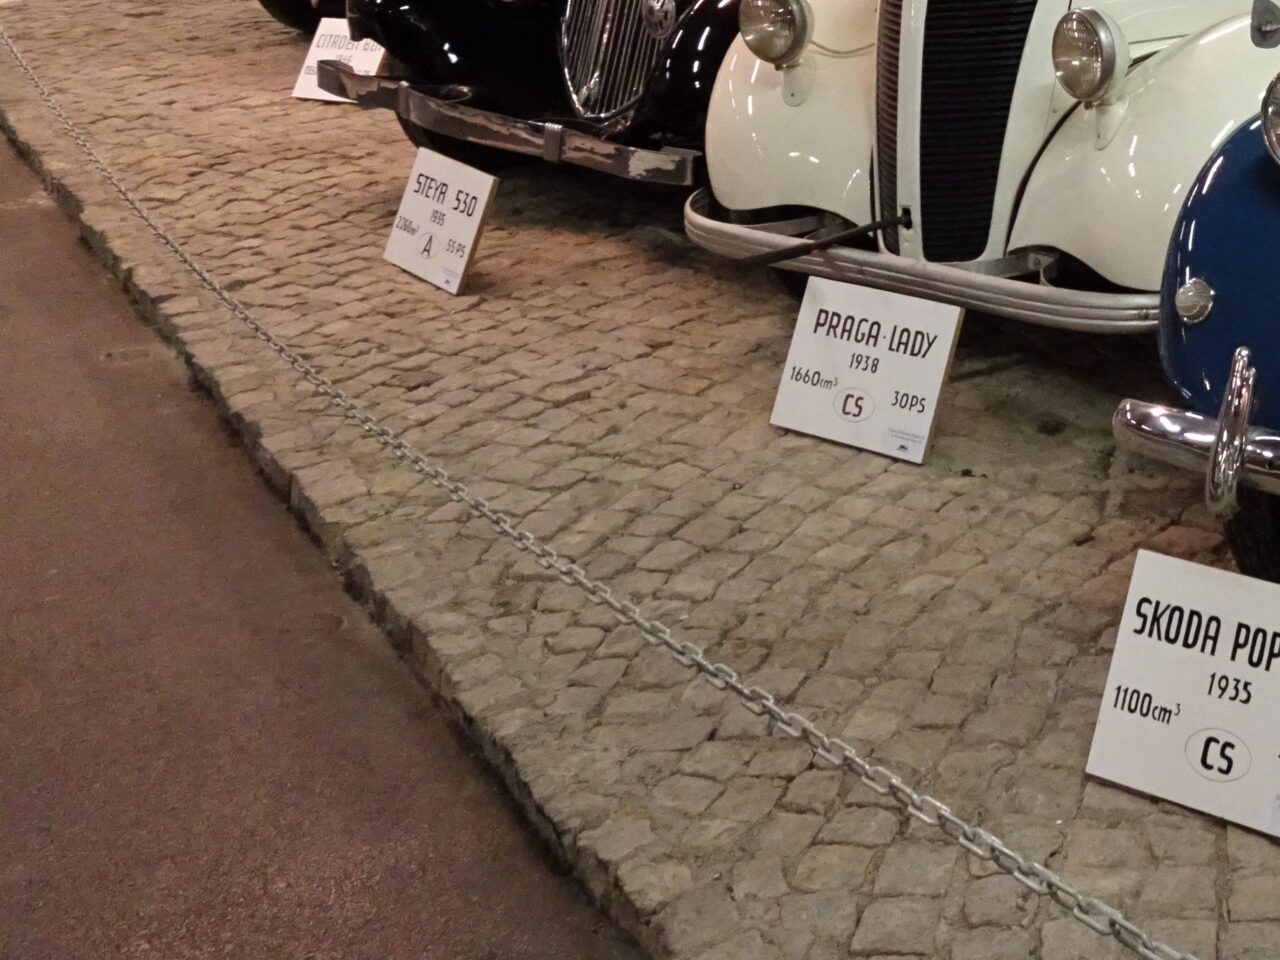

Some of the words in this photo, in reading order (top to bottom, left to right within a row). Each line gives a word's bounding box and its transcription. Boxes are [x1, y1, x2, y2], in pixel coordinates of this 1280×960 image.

[414, 173, 448, 205] STEYR
[452, 189, 478, 217] 530
[421, 235, 433, 257] A
[813, 308, 881, 347] PRAGA
[888, 325, 938, 358] LADY
[849, 352, 880, 374] 1938
[842, 394, 864, 417] CS
[891, 391, 926, 413] 30PS
[1133, 597, 1221, 656] SKODA
[1208, 672, 1252, 704] 1935
[1200, 736, 1235, 775] CS
